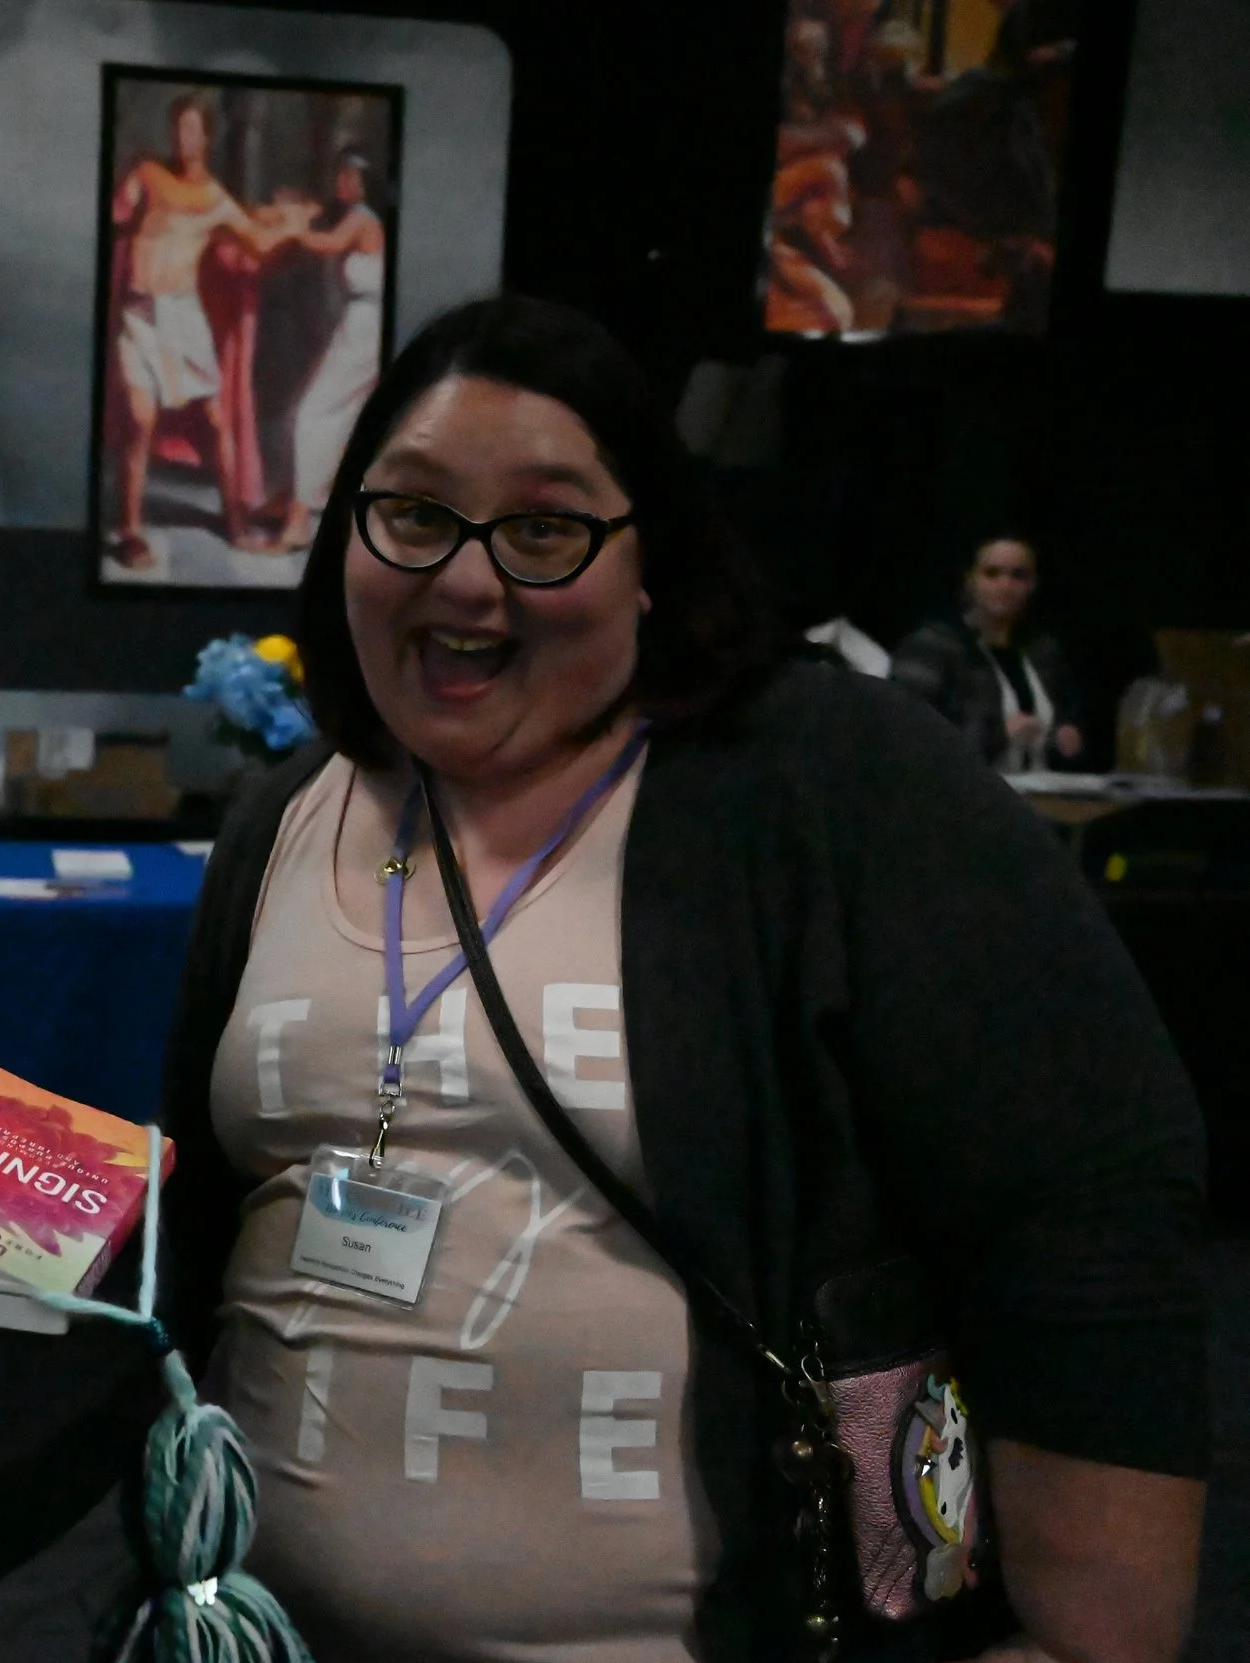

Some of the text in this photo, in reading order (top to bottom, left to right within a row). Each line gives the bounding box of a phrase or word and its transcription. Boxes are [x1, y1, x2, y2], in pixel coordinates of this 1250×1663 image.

[250, 983, 625, 1118] THE
[58, 1159, 109, 1184] UNIQUE
[341, 1236, 372, 1253] Susan
[297, 1345, 662, 1499] IFE
